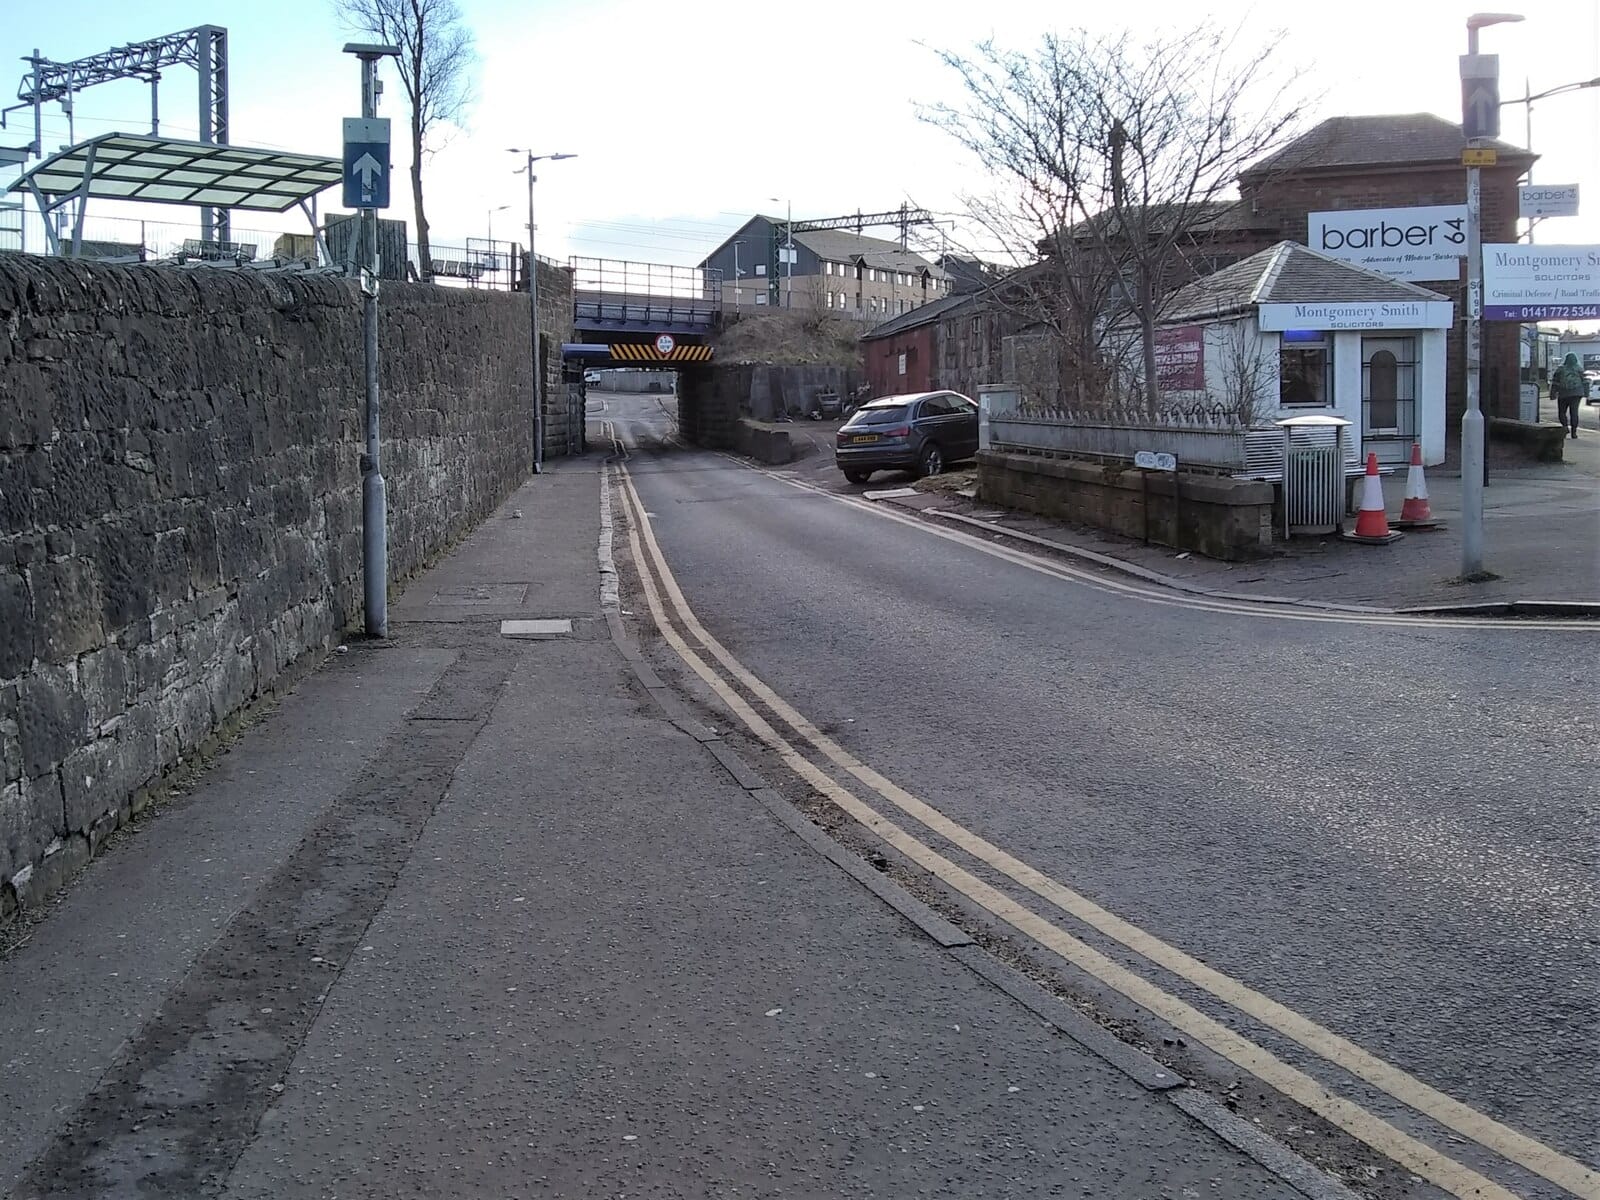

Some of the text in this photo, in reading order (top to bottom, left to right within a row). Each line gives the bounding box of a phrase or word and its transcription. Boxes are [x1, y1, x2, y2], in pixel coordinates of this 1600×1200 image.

[1522, 190, 1565, 200] barber
[1322, 217, 1466, 250] barber 64
[1495, 252, 1582, 271] Montgomery
[1492, 289, 1522, 298] Criminal
[1525, 289, 1551, 298] Defence
[1561, 289, 1579, 297] Road
[1295, 303, 1419, 321] Montgomery Smith
[1521, 307, 1547, 317] 0141
[1550, 306, 1569, 317] 772
[1571, 306, 1597, 317] 5344
[1330, 321, 1384, 329] SOLICITORS
